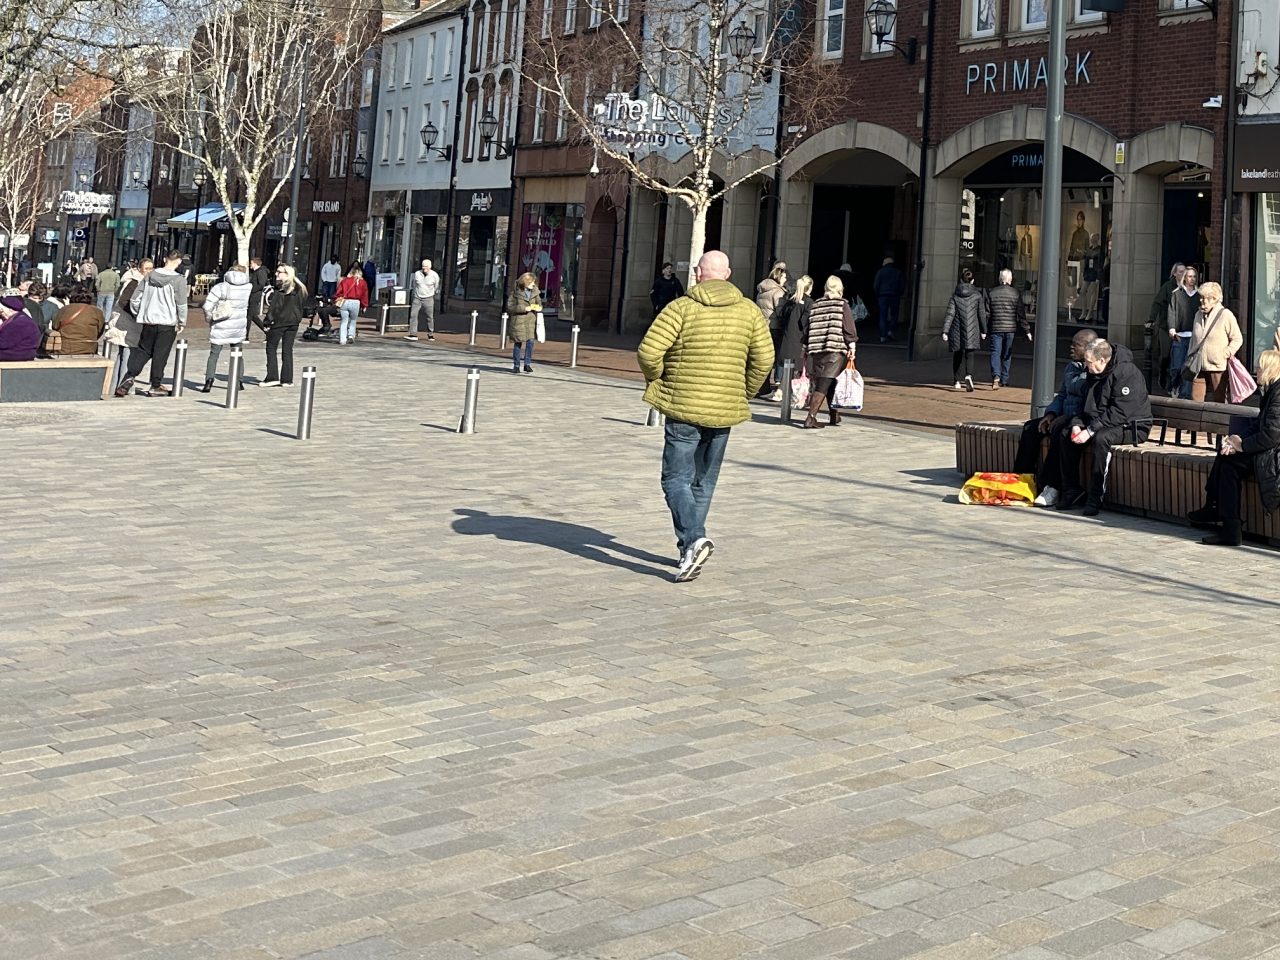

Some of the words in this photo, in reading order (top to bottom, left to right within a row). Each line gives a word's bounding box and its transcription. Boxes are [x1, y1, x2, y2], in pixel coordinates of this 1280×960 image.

[605, 93, 646, 121] The
[1012, 154, 1044, 167] PRIMA
[312, 201, 325, 212] RIVER
[324, 201, 340, 213] ISLAND
